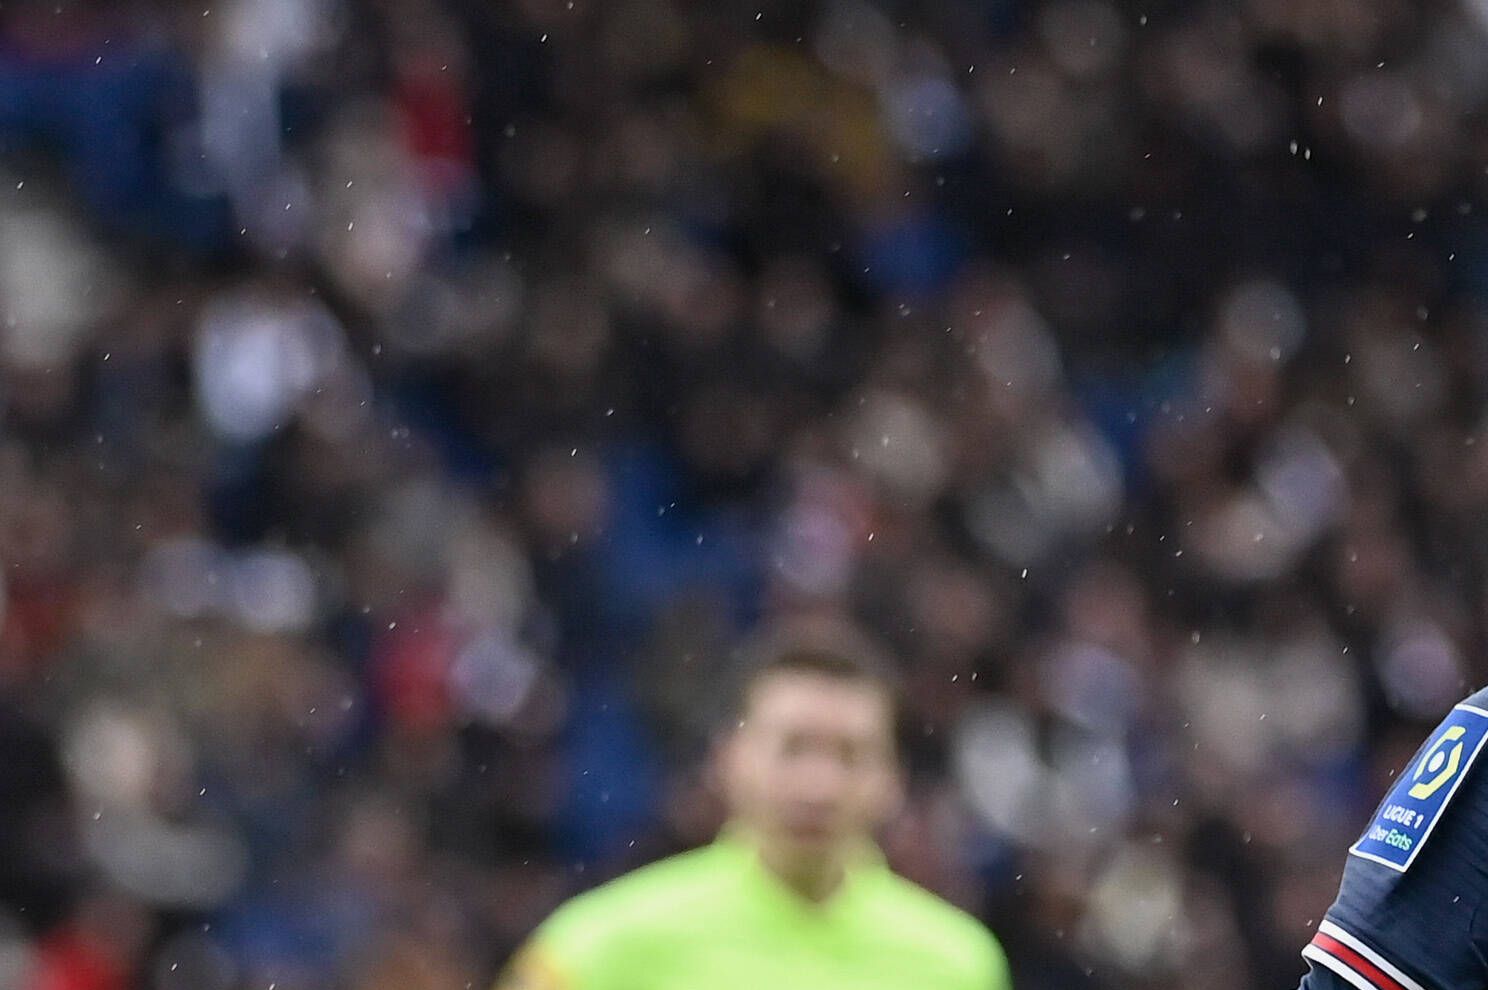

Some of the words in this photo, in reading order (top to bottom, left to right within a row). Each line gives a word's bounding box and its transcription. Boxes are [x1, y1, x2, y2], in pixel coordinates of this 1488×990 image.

[1383, 804, 1417, 827] LIGUE
[1413, 814, 1424, 829] 1
[1385, 828, 1412, 851] Eats
